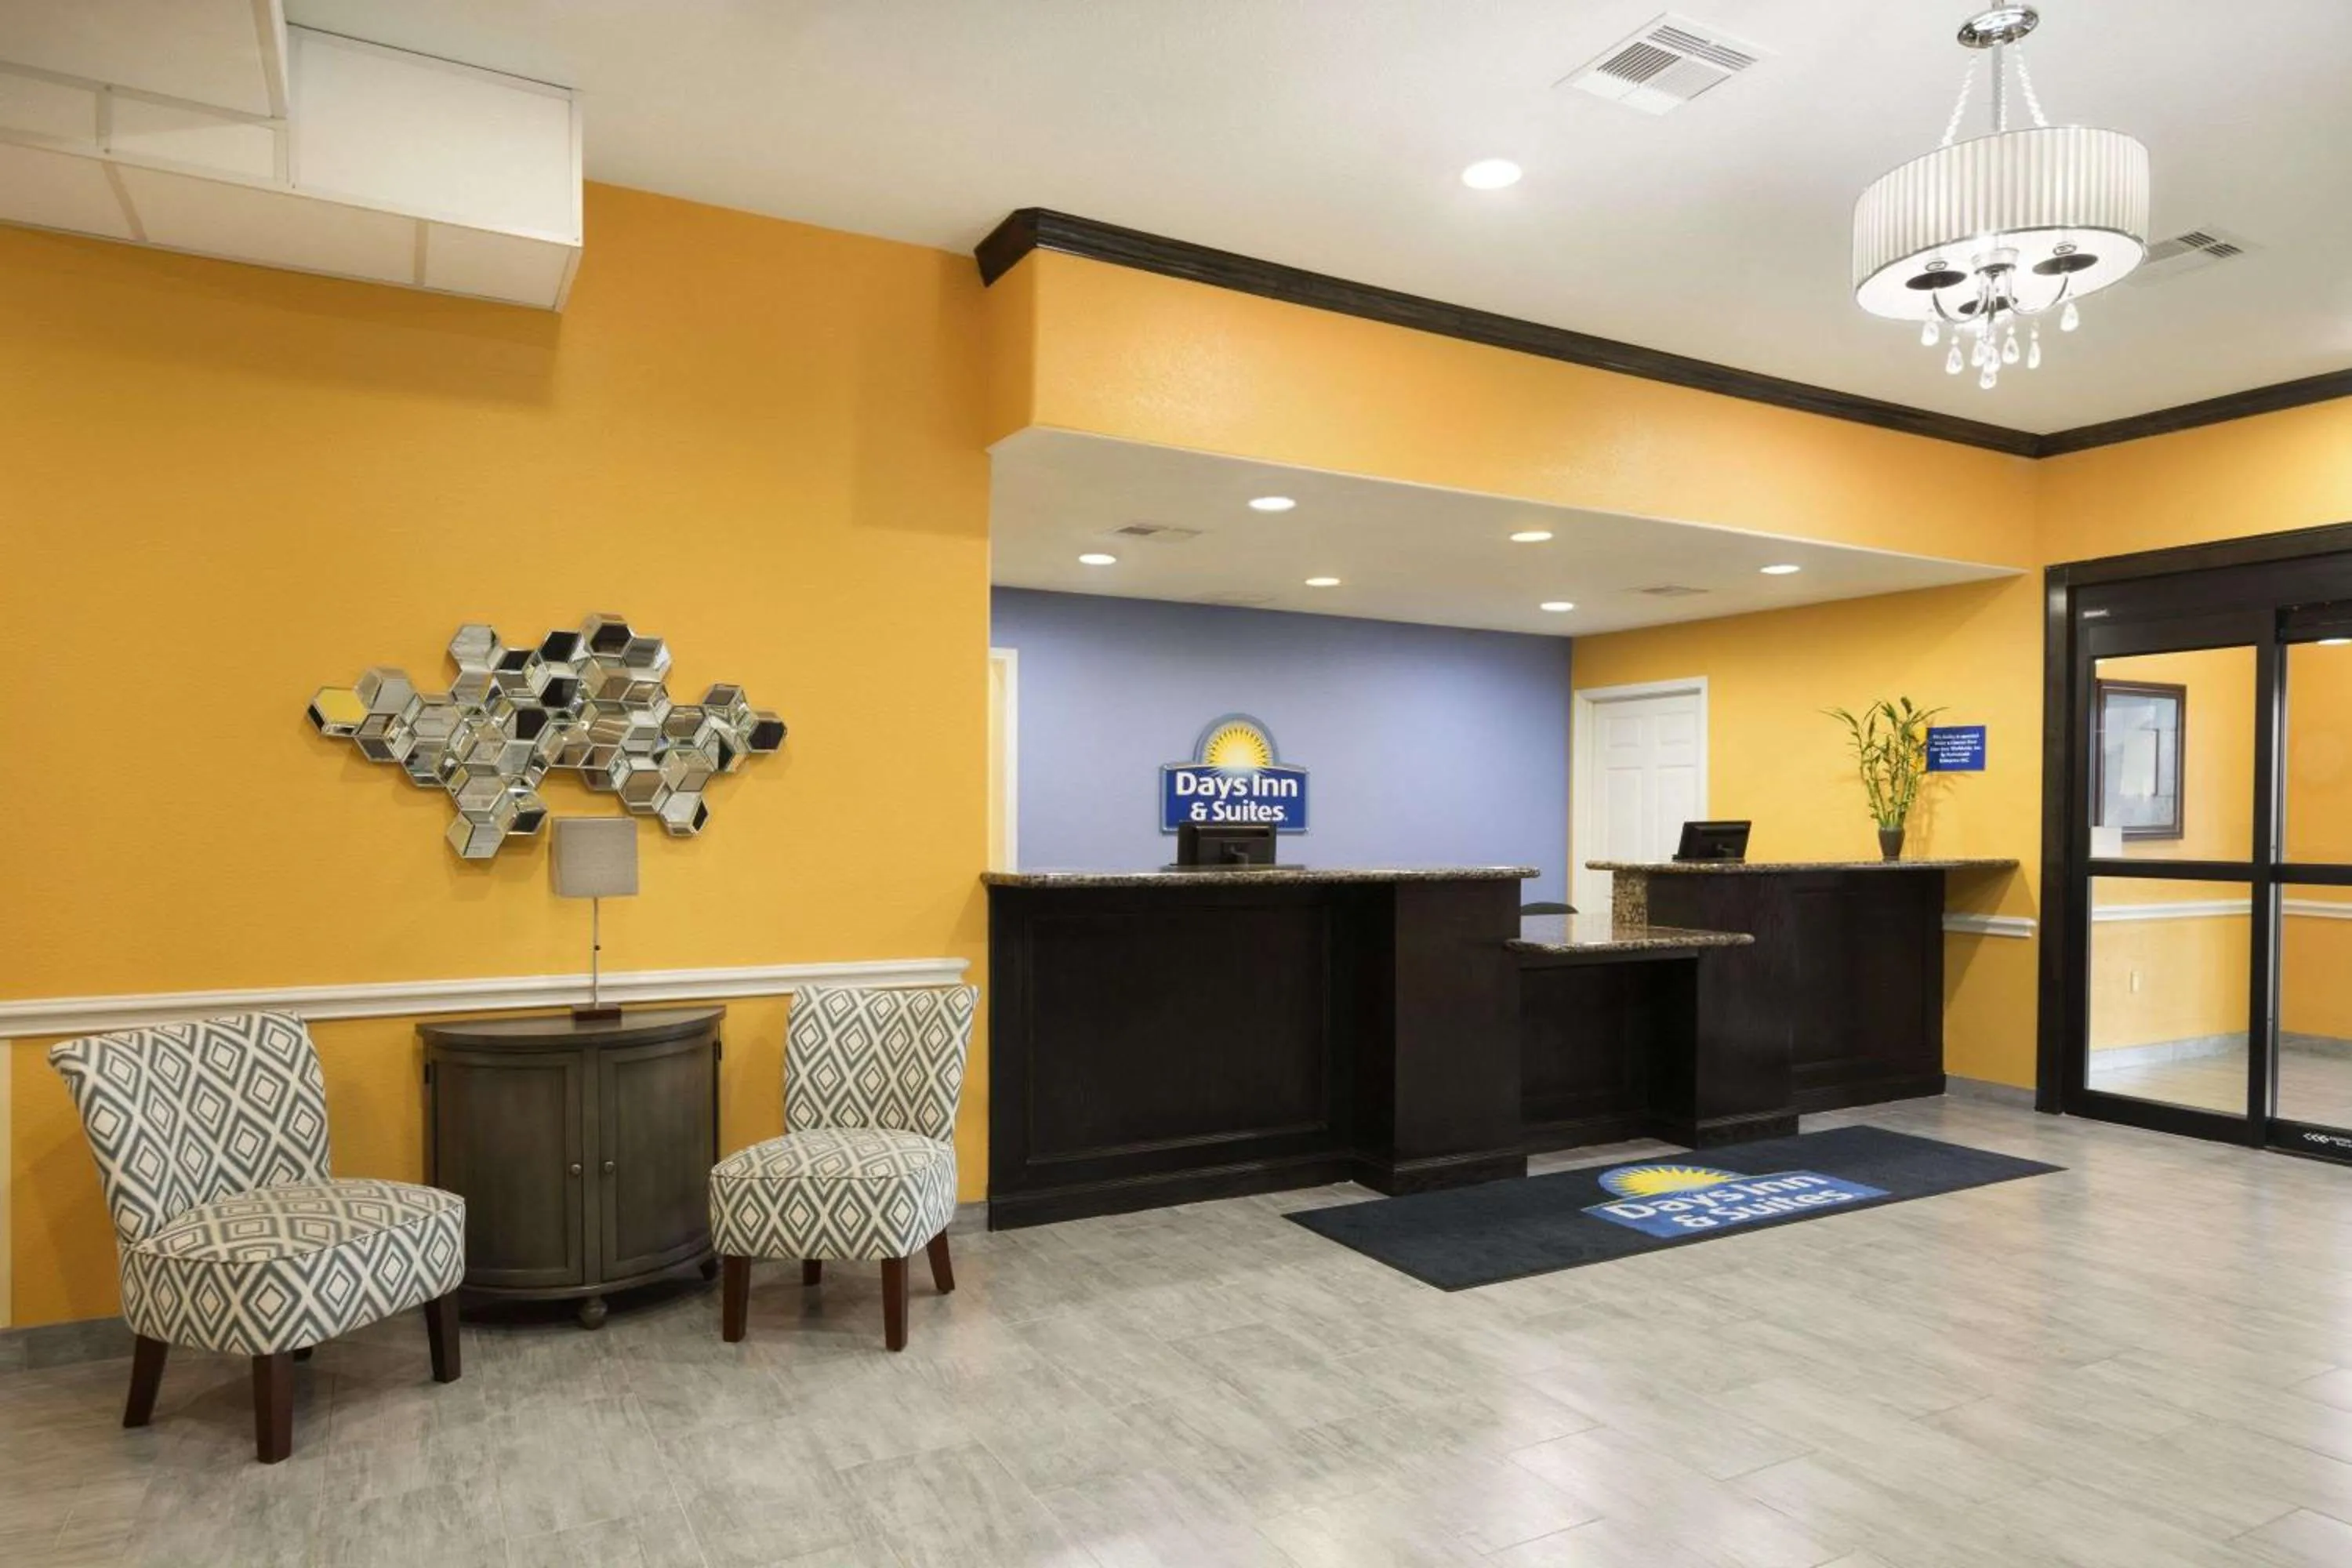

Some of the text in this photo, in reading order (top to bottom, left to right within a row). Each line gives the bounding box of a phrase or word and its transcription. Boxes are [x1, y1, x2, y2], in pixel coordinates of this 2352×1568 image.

[1176, 771, 1298, 799] Days Inn
[1190, 799, 1285, 822] & Suites
[1602, 1175, 1830, 1220] Days Inn
[1671, 1189, 1854, 1227] & Suites
